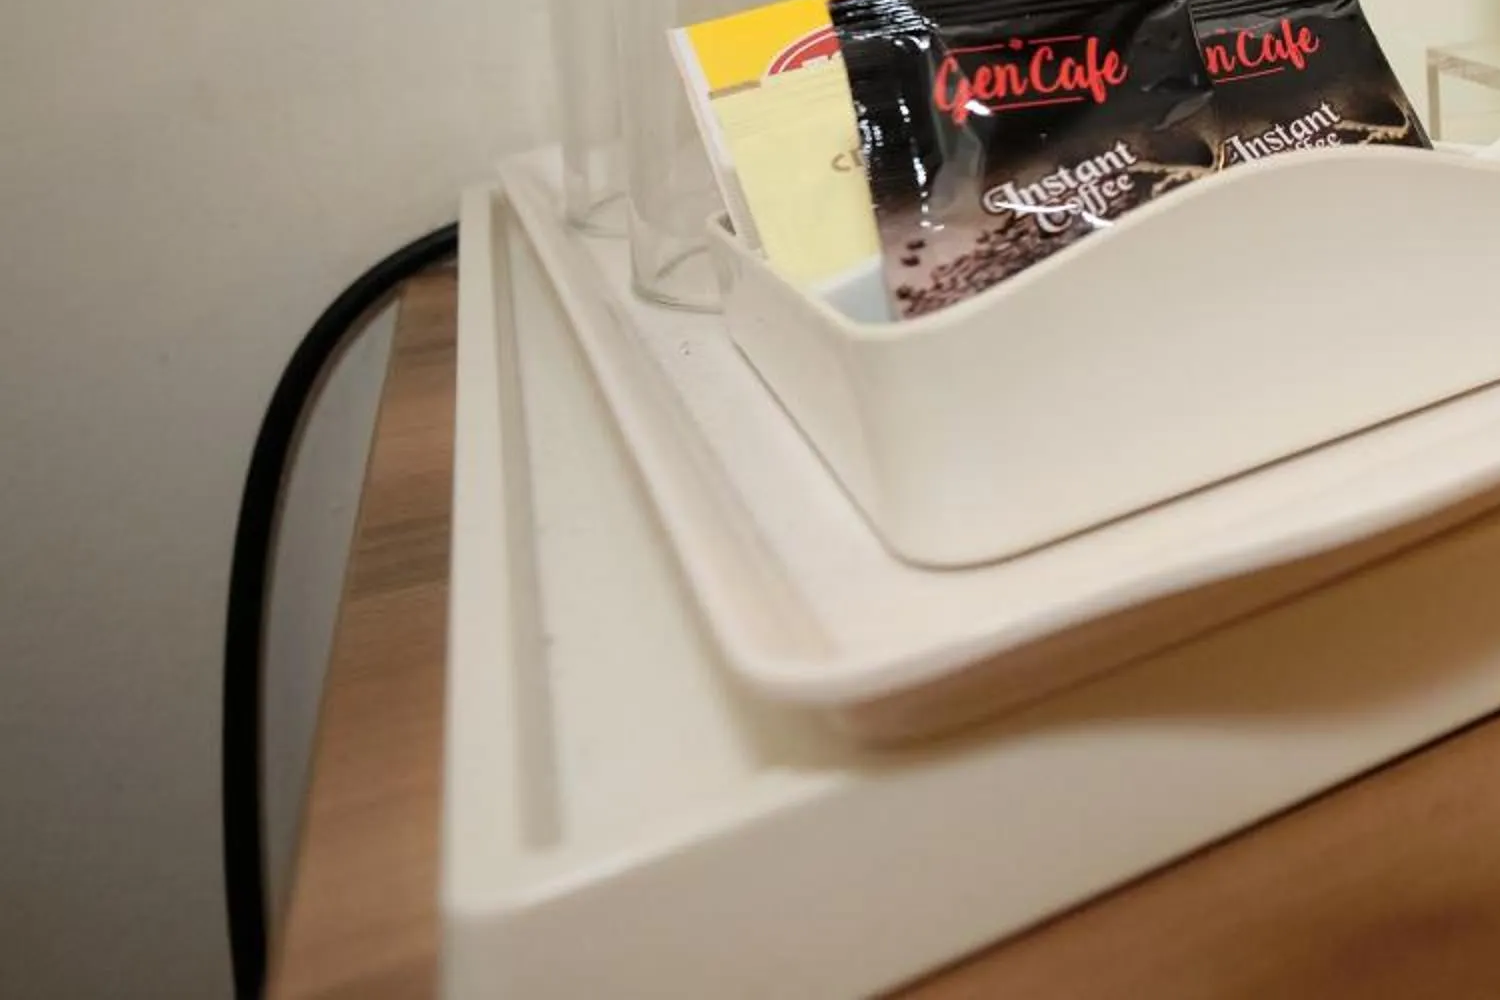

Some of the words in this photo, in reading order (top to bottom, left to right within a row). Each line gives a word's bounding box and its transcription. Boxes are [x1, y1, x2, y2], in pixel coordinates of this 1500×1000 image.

[1029, 37, 1128, 104] Cafe
[1236, 16, 1321, 70] Cafe
[1224, 100, 1341, 164] Instant
[983, 139, 1138, 218] Instant
[1036, 172, 1135, 234] Coffee
